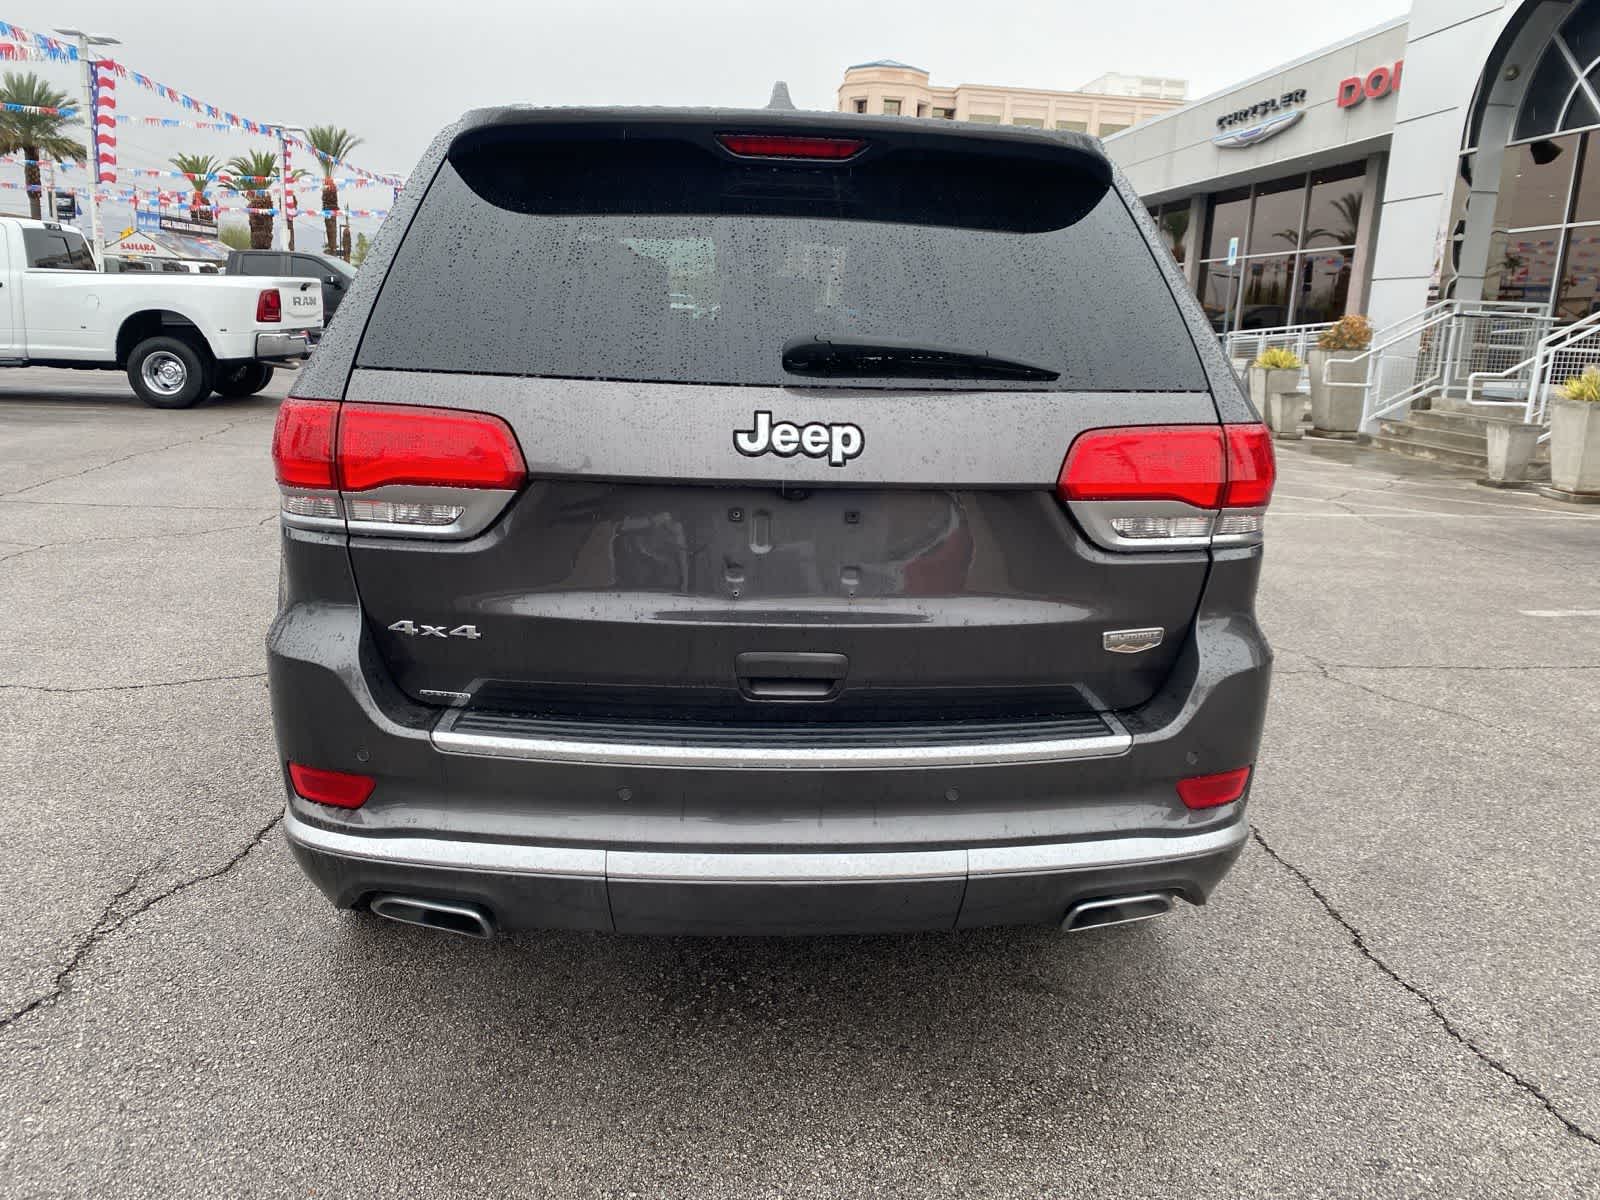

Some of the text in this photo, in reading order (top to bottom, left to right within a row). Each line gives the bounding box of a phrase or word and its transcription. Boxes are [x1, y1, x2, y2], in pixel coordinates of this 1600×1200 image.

[120, 241, 157, 252] SAHARA
[293, 296, 317, 306] RAM
[733, 410, 866, 467] Jeep
